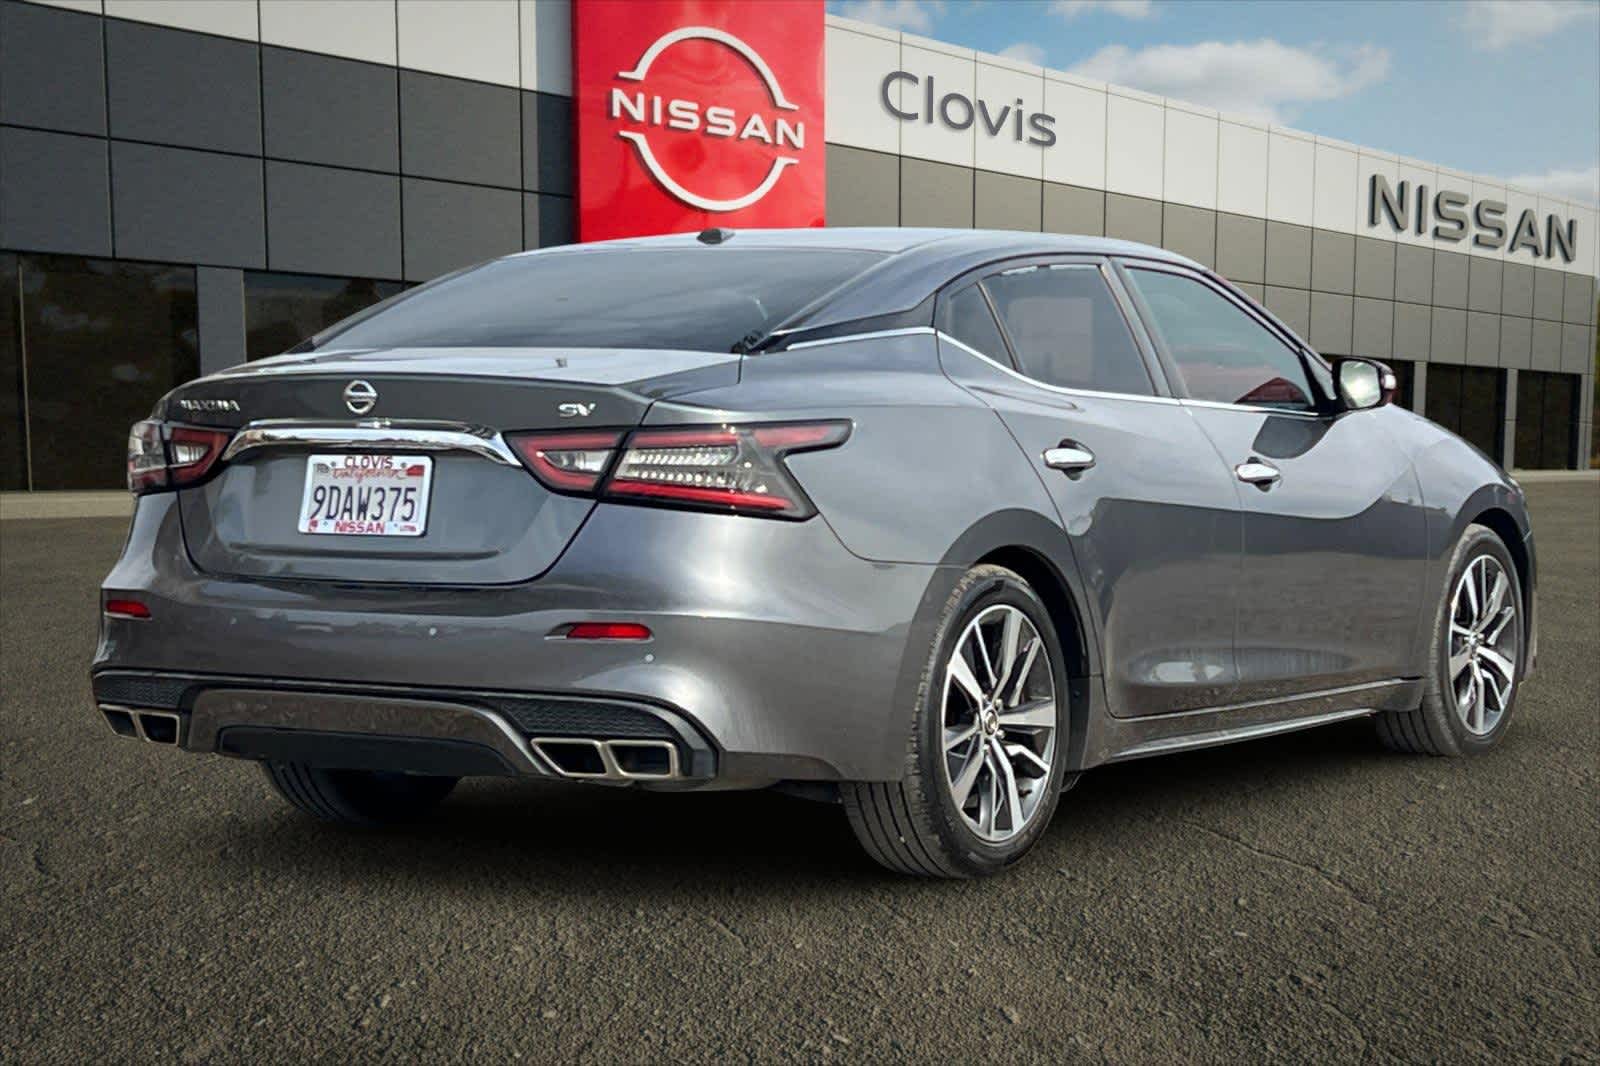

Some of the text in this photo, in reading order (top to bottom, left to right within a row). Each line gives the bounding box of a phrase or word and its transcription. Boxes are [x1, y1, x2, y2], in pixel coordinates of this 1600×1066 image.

[611, 87, 805, 149] NISSAN
[881, 70, 1057, 147] Clovis
[1367, 173, 1578, 263] NISSAN
[558, 403, 596, 417] SV
[344, 455, 393, 468] CLOVIS
[310, 485, 416, 521] 9DAW375
[334, 521, 385, 533] NISSAN
